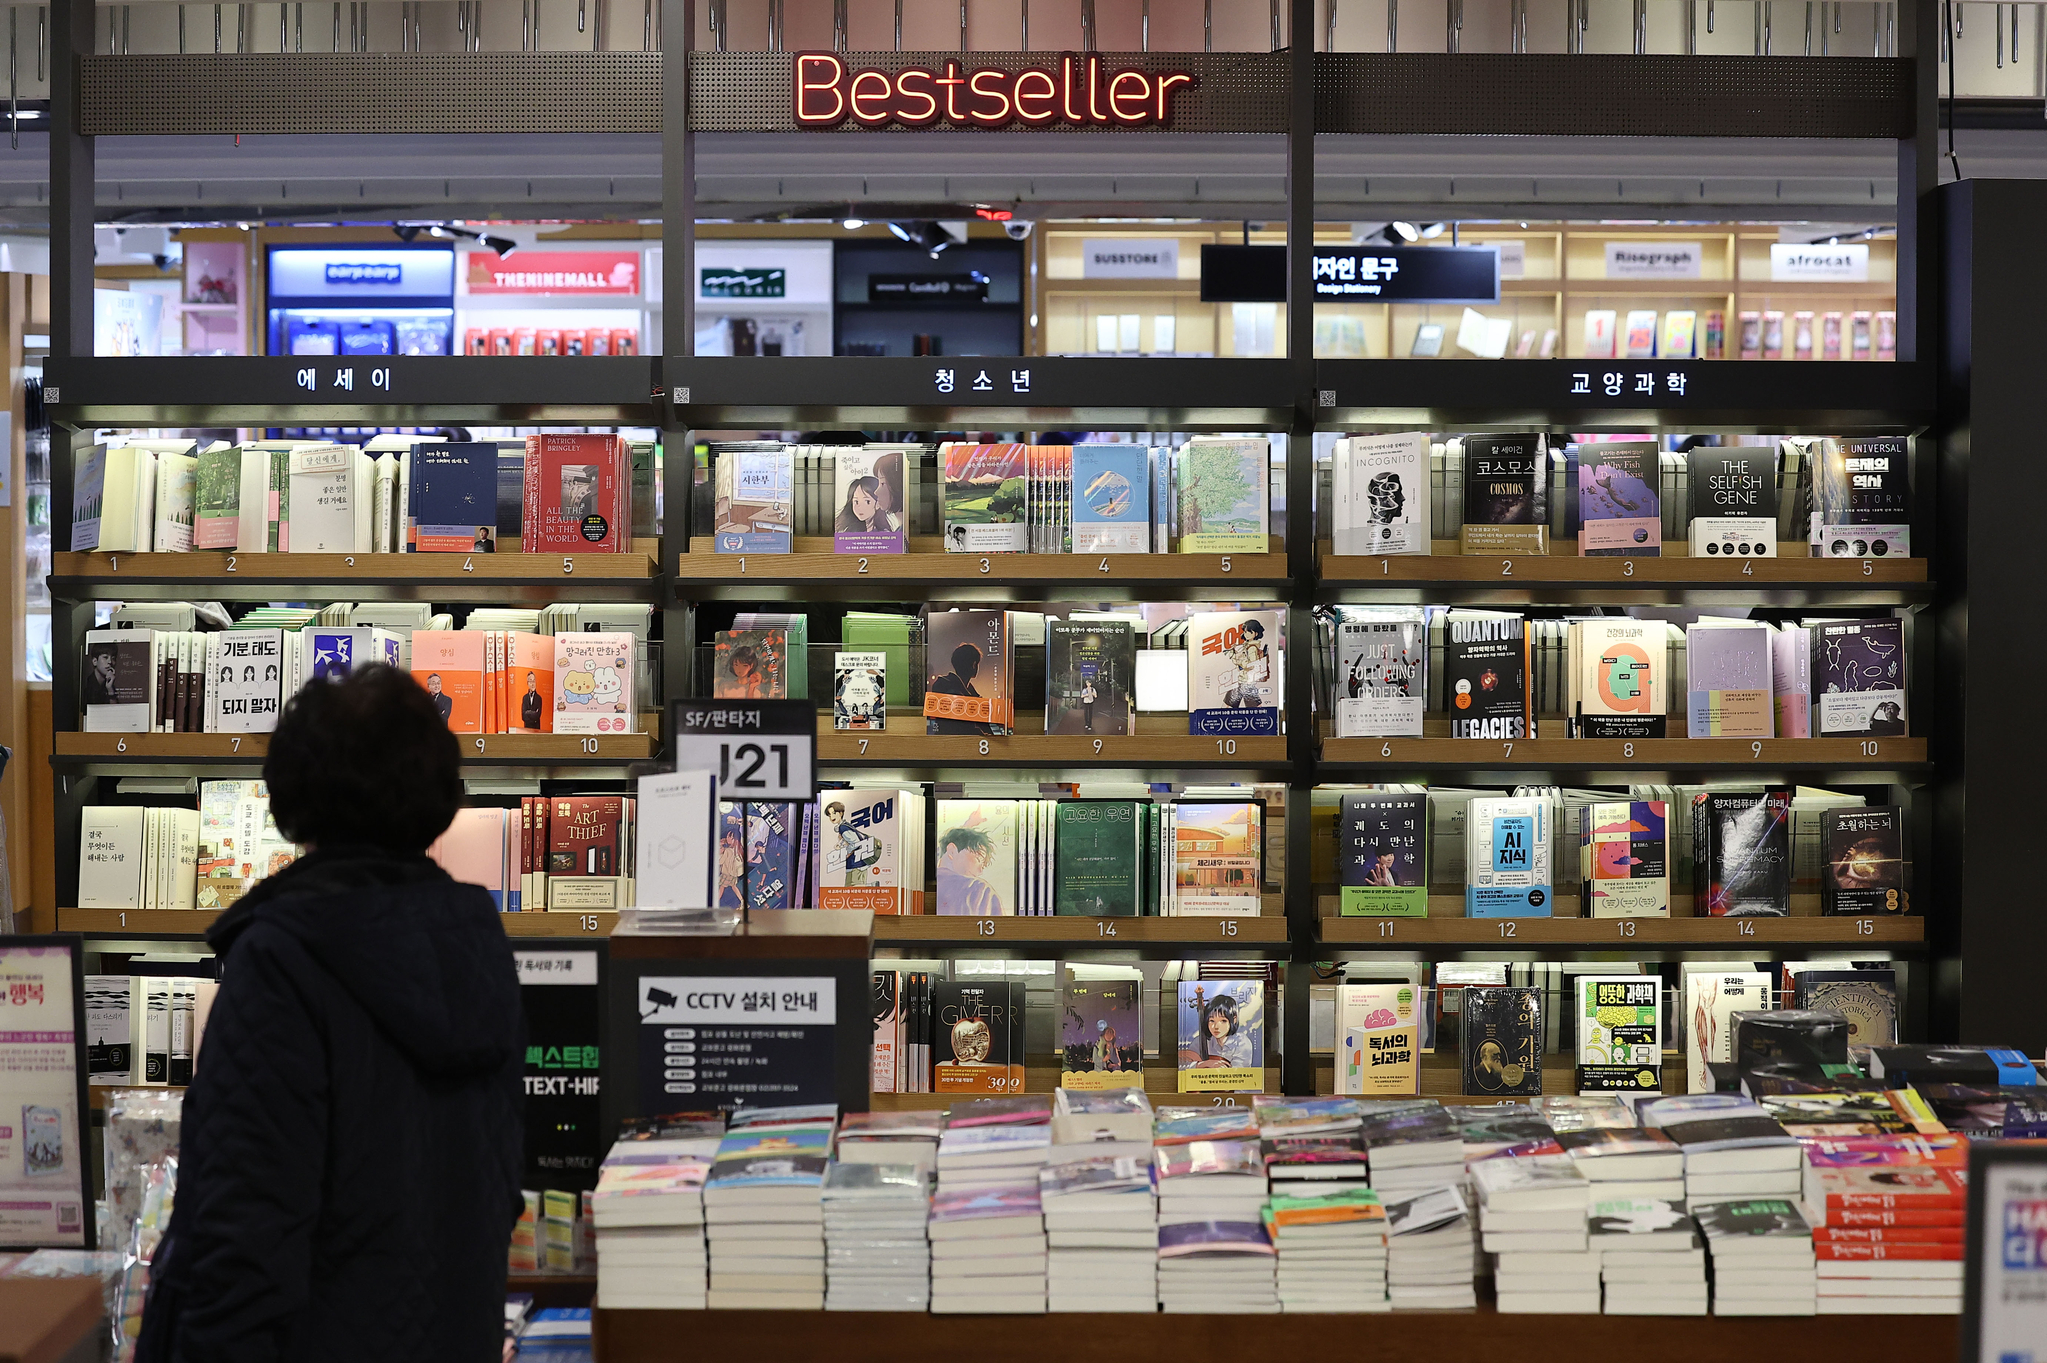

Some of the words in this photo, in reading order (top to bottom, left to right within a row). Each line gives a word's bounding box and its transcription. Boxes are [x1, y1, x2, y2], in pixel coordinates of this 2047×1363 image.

[796, 53, 1193, 122] Bestseller
[1615, 251, 1692, 265] Risograph
[1787, 254, 1853, 267] afrocat
[1361, 256, 1399, 281] 문구
[494, 272, 608, 288] THENINEMALL
[296, 368, 392, 392] 에세이
[934, 367, 1032, 393] 청소년
[1570, 371, 1689, 397] 교양과학
[547, 437, 577, 445] PATRICK
[1851, 443, 1903, 454] UNIVERSAL
[1491, 446, 1500, 455] 칼
[1501, 445, 1523, 454] 세이건
[1356, 454, 1415, 467] INCOGNITO
[1476, 460, 1538, 476] 코스모스
[1602, 461, 1623, 471] Why
[1624, 460, 1641, 469] Fish
[1721, 460, 1749, 475] THE
[1845, 457, 1890, 472] 존재의
[741, 474, 771, 486] 시한부
[1601, 471, 1622, 480] Don't
[1624, 470, 1645, 479] Exist
[1852, 475, 1883, 489] 역사
[1489, 482, 1524, 496] COSMOS
[1713, 490, 1758, 505] GENE
[1838, 494, 1904, 505] ISTORY
[546, 507, 564, 515] ALL
[566, 507, 584, 515] THE
[546, 516, 582, 524] BEAUTY
[546, 525, 555, 533] IN
[557, 525, 575, 533] THE
[546, 534, 579, 543] WORLD
[110, 556, 118, 571] 1
[226, 557, 237, 572] 2
[463, 557, 474, 572] 4
[563, 557, 573, 573] 5
[738, 557, 746, 573] 1
[858, 557, 869, 573] 2
[978, 558, 990, 573] 3
[1098, 557, 1110, 573] 4
[1221, 556, 1232, 572] 5
[1381, 559, 1389, 574] 1
[1502, 560, 1512, 575] 2
[1623, 561, 1633, 576] 3
[1742, 560, 1753, 576] 4
[1863, 560, 1873, 576] 5
[987, 617, 1000, 657] 아몬드
[1451, 618, 1523, 644] QUANTUM
[1202, 623, 1247, 656] 국어
[439, 648, 455, 658] 양심
[566, 646, 595, 657] 망그러진
[596, 646, 615, 657] 만화
[1366, 644, 1396, 660] JUST
[1347, 663, 1416, 681] FOLLOWING
[1357, 685, 1406, 699] ORDERS
[222, 698, 248, 715] 되지
[250, 697, 277, 714] 말자
[685, 709, 761, 729] SF/판타지
[1452, 716, 1525, 740] LEGACIES
[117, 737, 127, 752] 6
[231, 737, 241, 753] 7
[476, 738, 485, 753] 9
[581, 738, 598, 753] 10
[858, 739, 869, 754] 7
[979, 739, 989, 755] 8
[1093, 739, 1103, 754] 9
[1216, 739, 1236, 755] 10
[1381, 742, 1391, 757] 6
[1503, 743, 1514, 758] 7
[1624, 742, 1634, 758] 8
[1751, 741, 1762, 758] 9
[1860, 741, 1878, 757] 10
[1767, 797, 1786, 809] 미래
[574, 809, 600, 825] ART
[851, 797, 894, 829] 국어
[1064, 808, 1102, 822] 고요한
[1105, 806, 1132, 821] 우연
[566, 822, 608, 841] THIEF
[1836, 818, 1880, 831] 초월하는
[1881, 817, 1892, 830] 뇌
[88, 830, 103, 840] 결국
[1504, 831, 1521, 849] AI
[87, 841, 116, 851] 무엇이든
[87, 853, 109, 862] 해내는
[110, 853, 125, 863] 사람
[1499, 848, 1526, 865] 지식
[579, 915, 598, 931] 15
[976, 920, 995, 936] 13
[1096, 921, 1117, 937] 14
[1219, 920, 1238, 936] 15
[1378, 921, 1394, 937] 11
[1498, 922, 1516, 937] 12
[1617, 921, 1636, 937] 13
[1737, 920, 1755, 936] 14
[1856, 920, 1874, 936] 15
[1723, 977, 1745, 986] 우리는
[10, 983, 44, 1006] 행복
[686, 992, 735, 1010] CCTV
[741, 991, 777, 1012] 설치
[782, 991, 818, 1012] 안내
[961, 995, 984, 1006] THE
[1598, 984, 1626, 1005] 엉뚱한
[1626, 984, 1654, 1005] 과학책
[1824, 992, 1883, 1018] CIENTIFICA
[1841, 1005, 1873, 1023] TORICA
[875, 1043, 891, 1052] 선택
[1369, 1034, 1408, 1051] 독서의
[1371, 1050, 1412, 1067] 뇌과학
